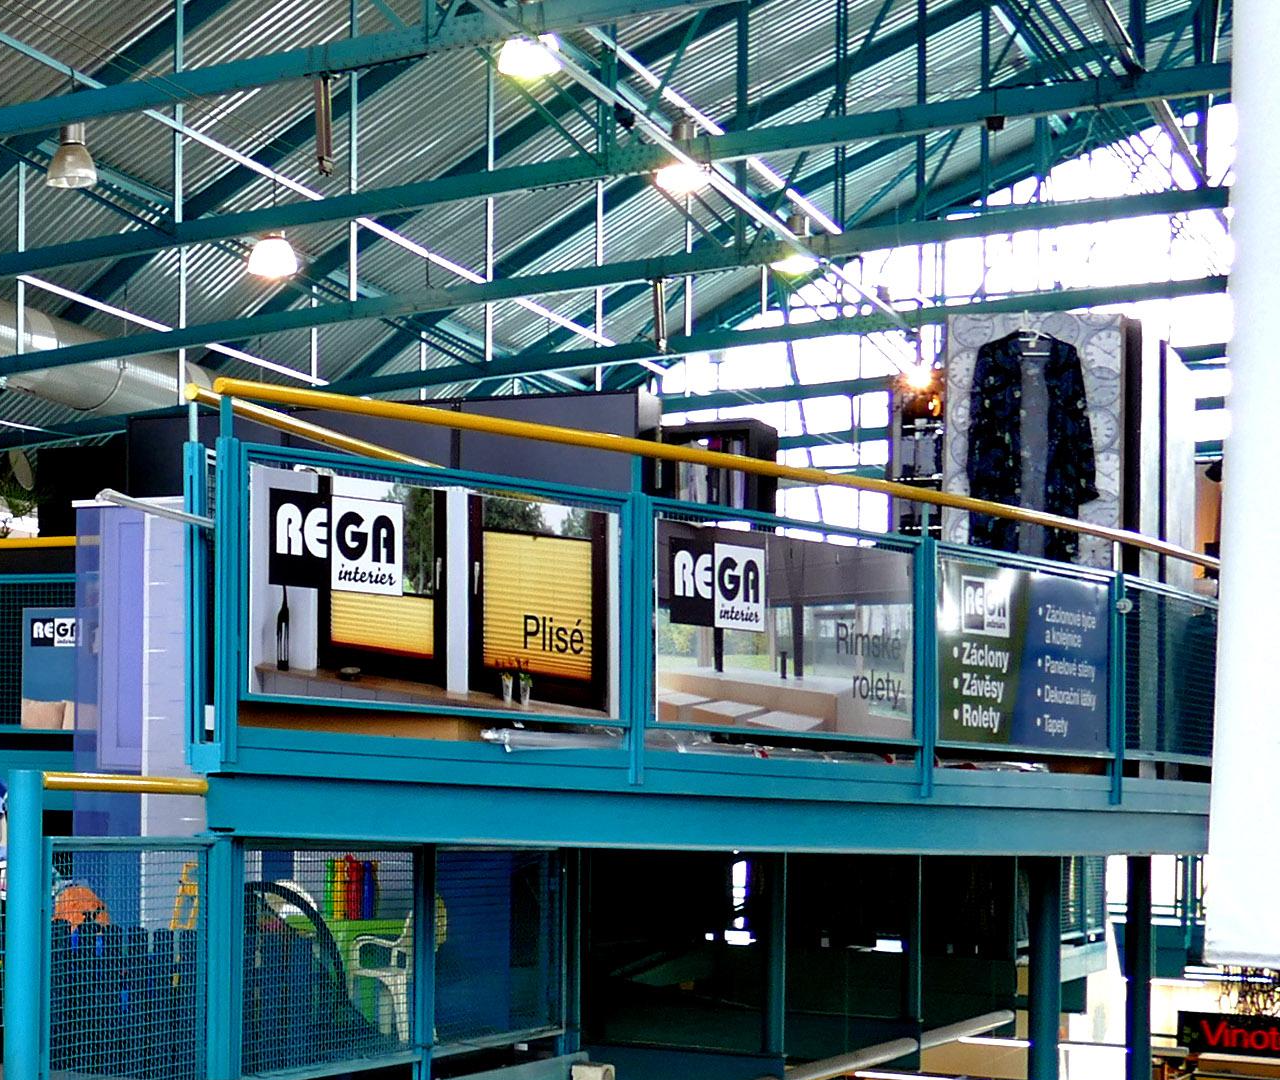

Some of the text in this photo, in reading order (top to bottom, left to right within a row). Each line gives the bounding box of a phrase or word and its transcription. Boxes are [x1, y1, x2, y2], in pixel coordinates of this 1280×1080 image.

[276, 502, 396, 565] REGA
[337, 563, 397, 587] interier
[673, 549, 760, 605] REGA
[719, 603, 761, 624] interier
[523, 614, 585, 655] Plisé
[961, 641, 1010, 674] Záclony
[852, 669, 901, 710] rolety
[961, 672, 1005, 704] Závěsy
[961, 703, 1001, 734] Rolety
[1043, 714, 1069, 738] Tapety
[1200, 1019, 1280, 1052] Vinot
